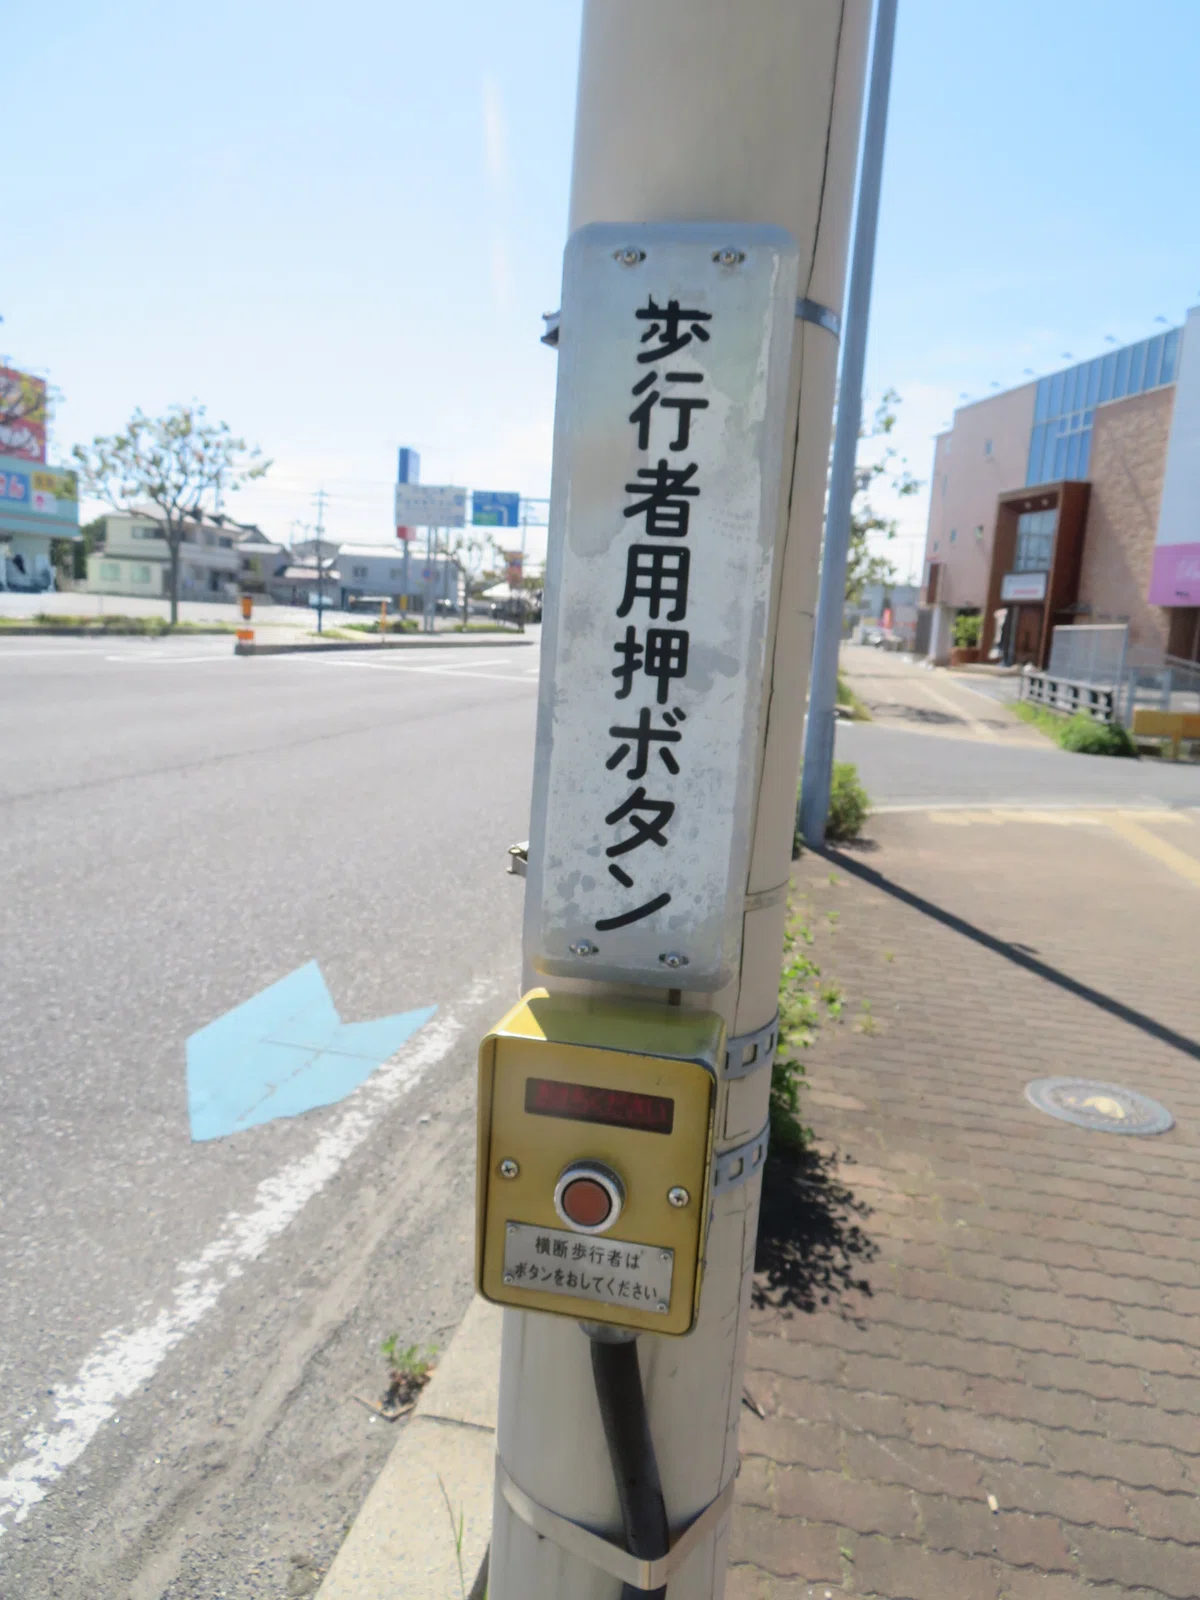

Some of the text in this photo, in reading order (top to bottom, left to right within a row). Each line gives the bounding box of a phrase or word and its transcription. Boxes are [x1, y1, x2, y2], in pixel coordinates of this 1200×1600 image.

[595, 296, 713, 931] 歩行者用押ボタン
[535, 1236, 640, 1270] 横断歩行者は
[514, 1261, 658, 1300] ボタンをおしてください
